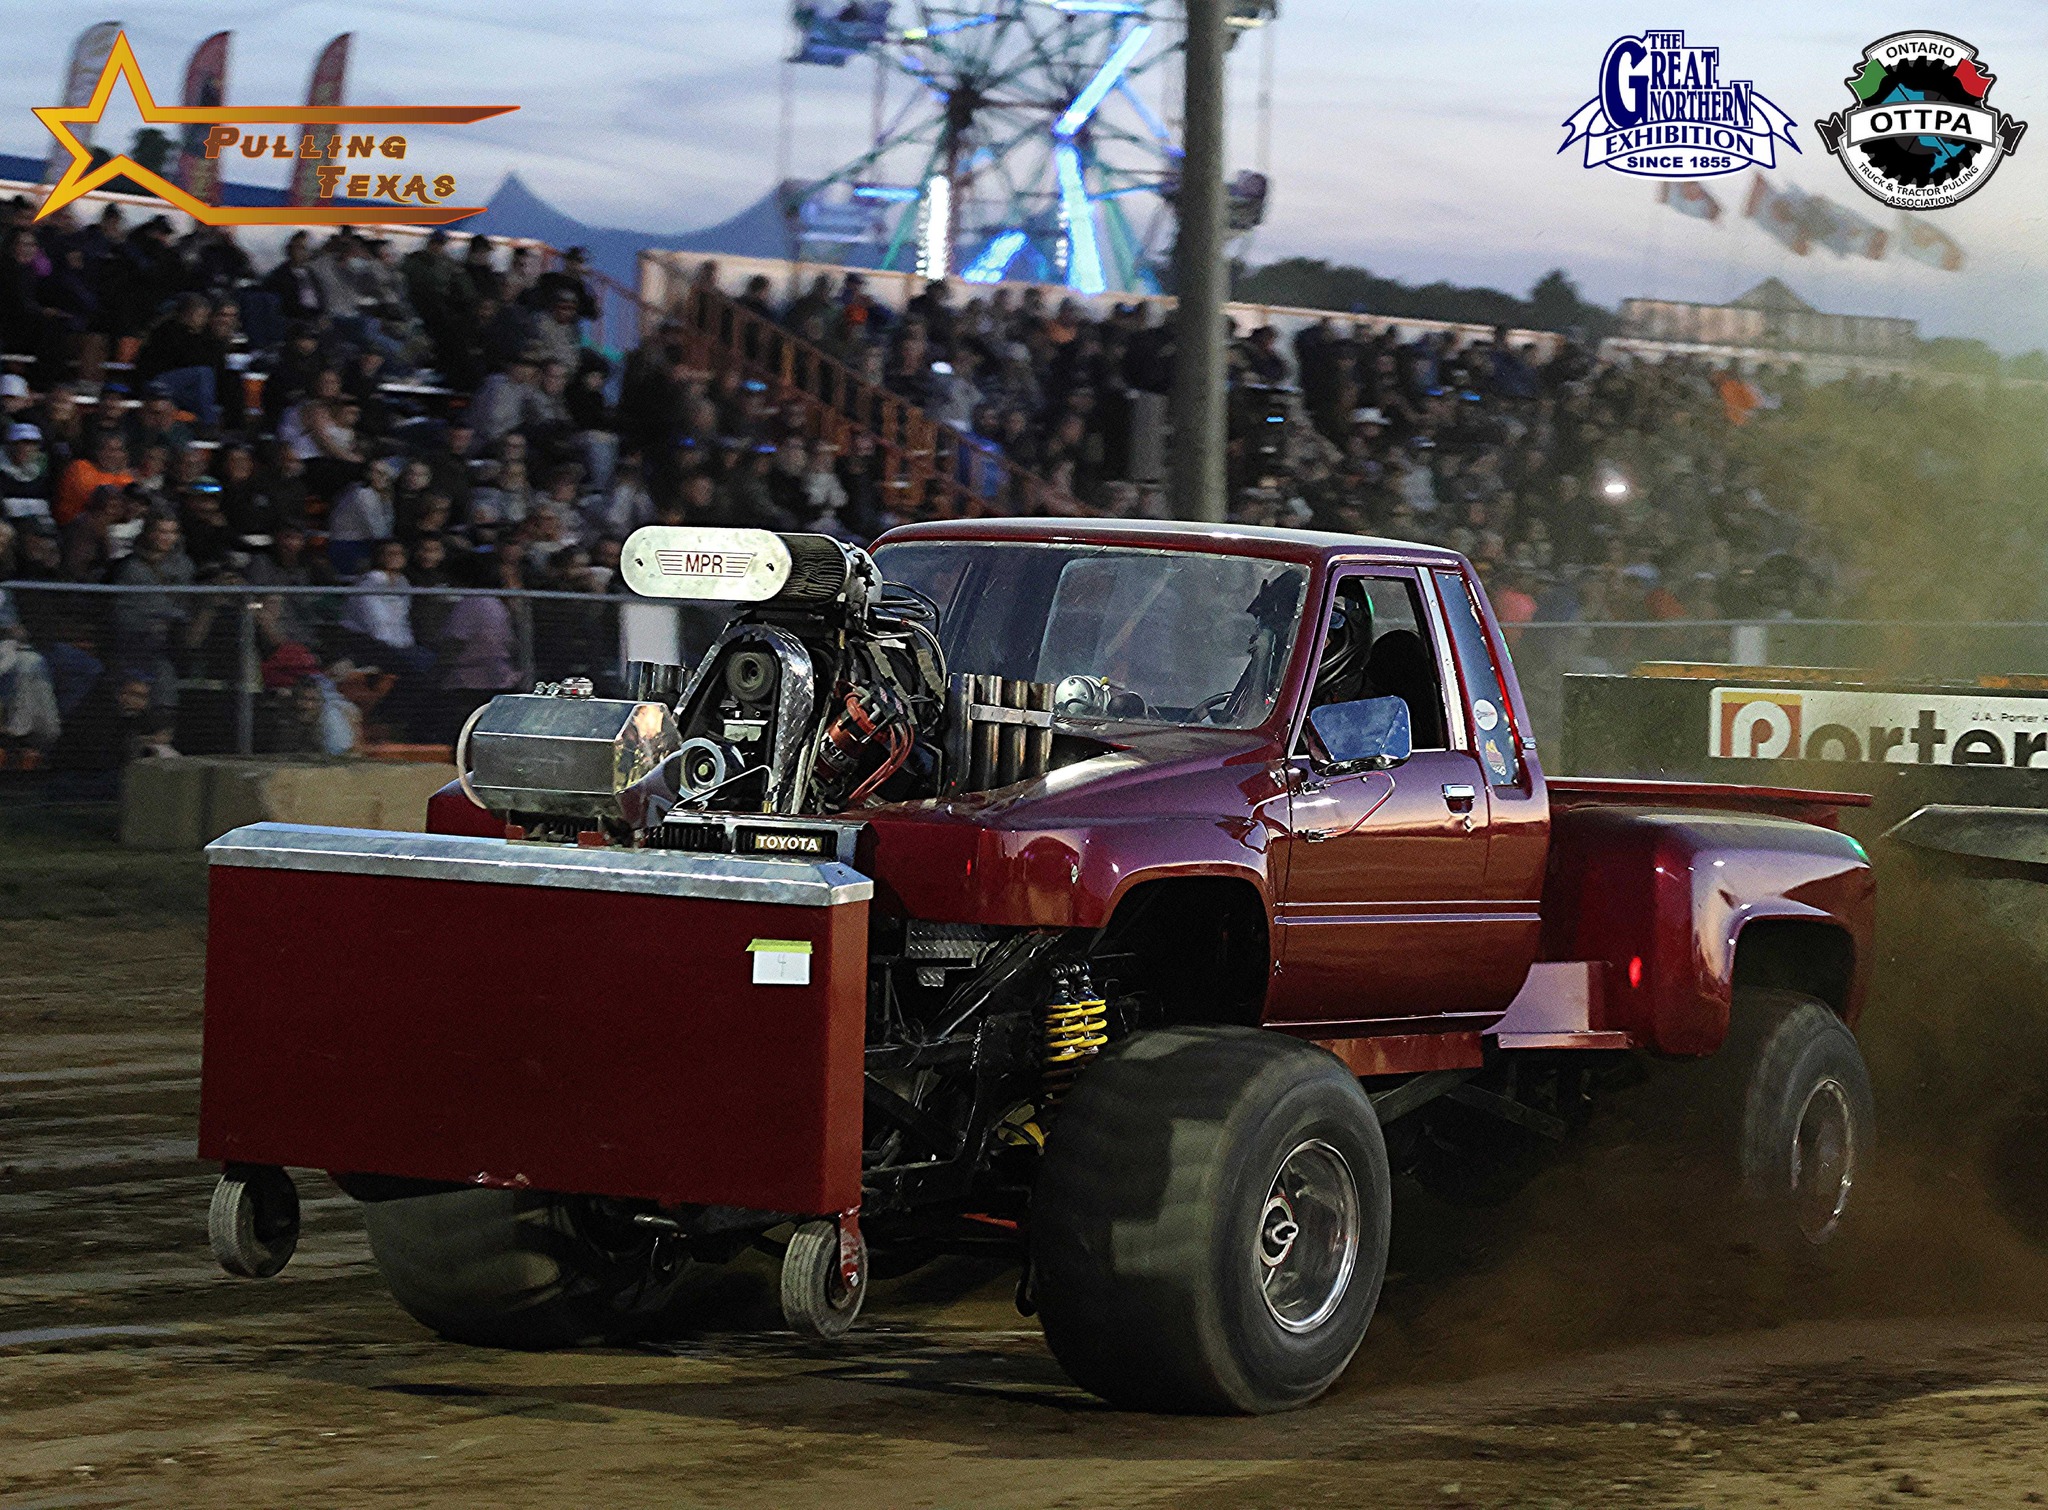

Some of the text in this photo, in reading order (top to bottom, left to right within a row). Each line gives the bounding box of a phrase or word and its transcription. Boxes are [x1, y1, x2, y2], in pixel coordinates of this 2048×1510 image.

[686, 554, 723, 573] MPR
[757, 836, 818, 851] TOYOTA
[777, 953, 787, 977] 4
